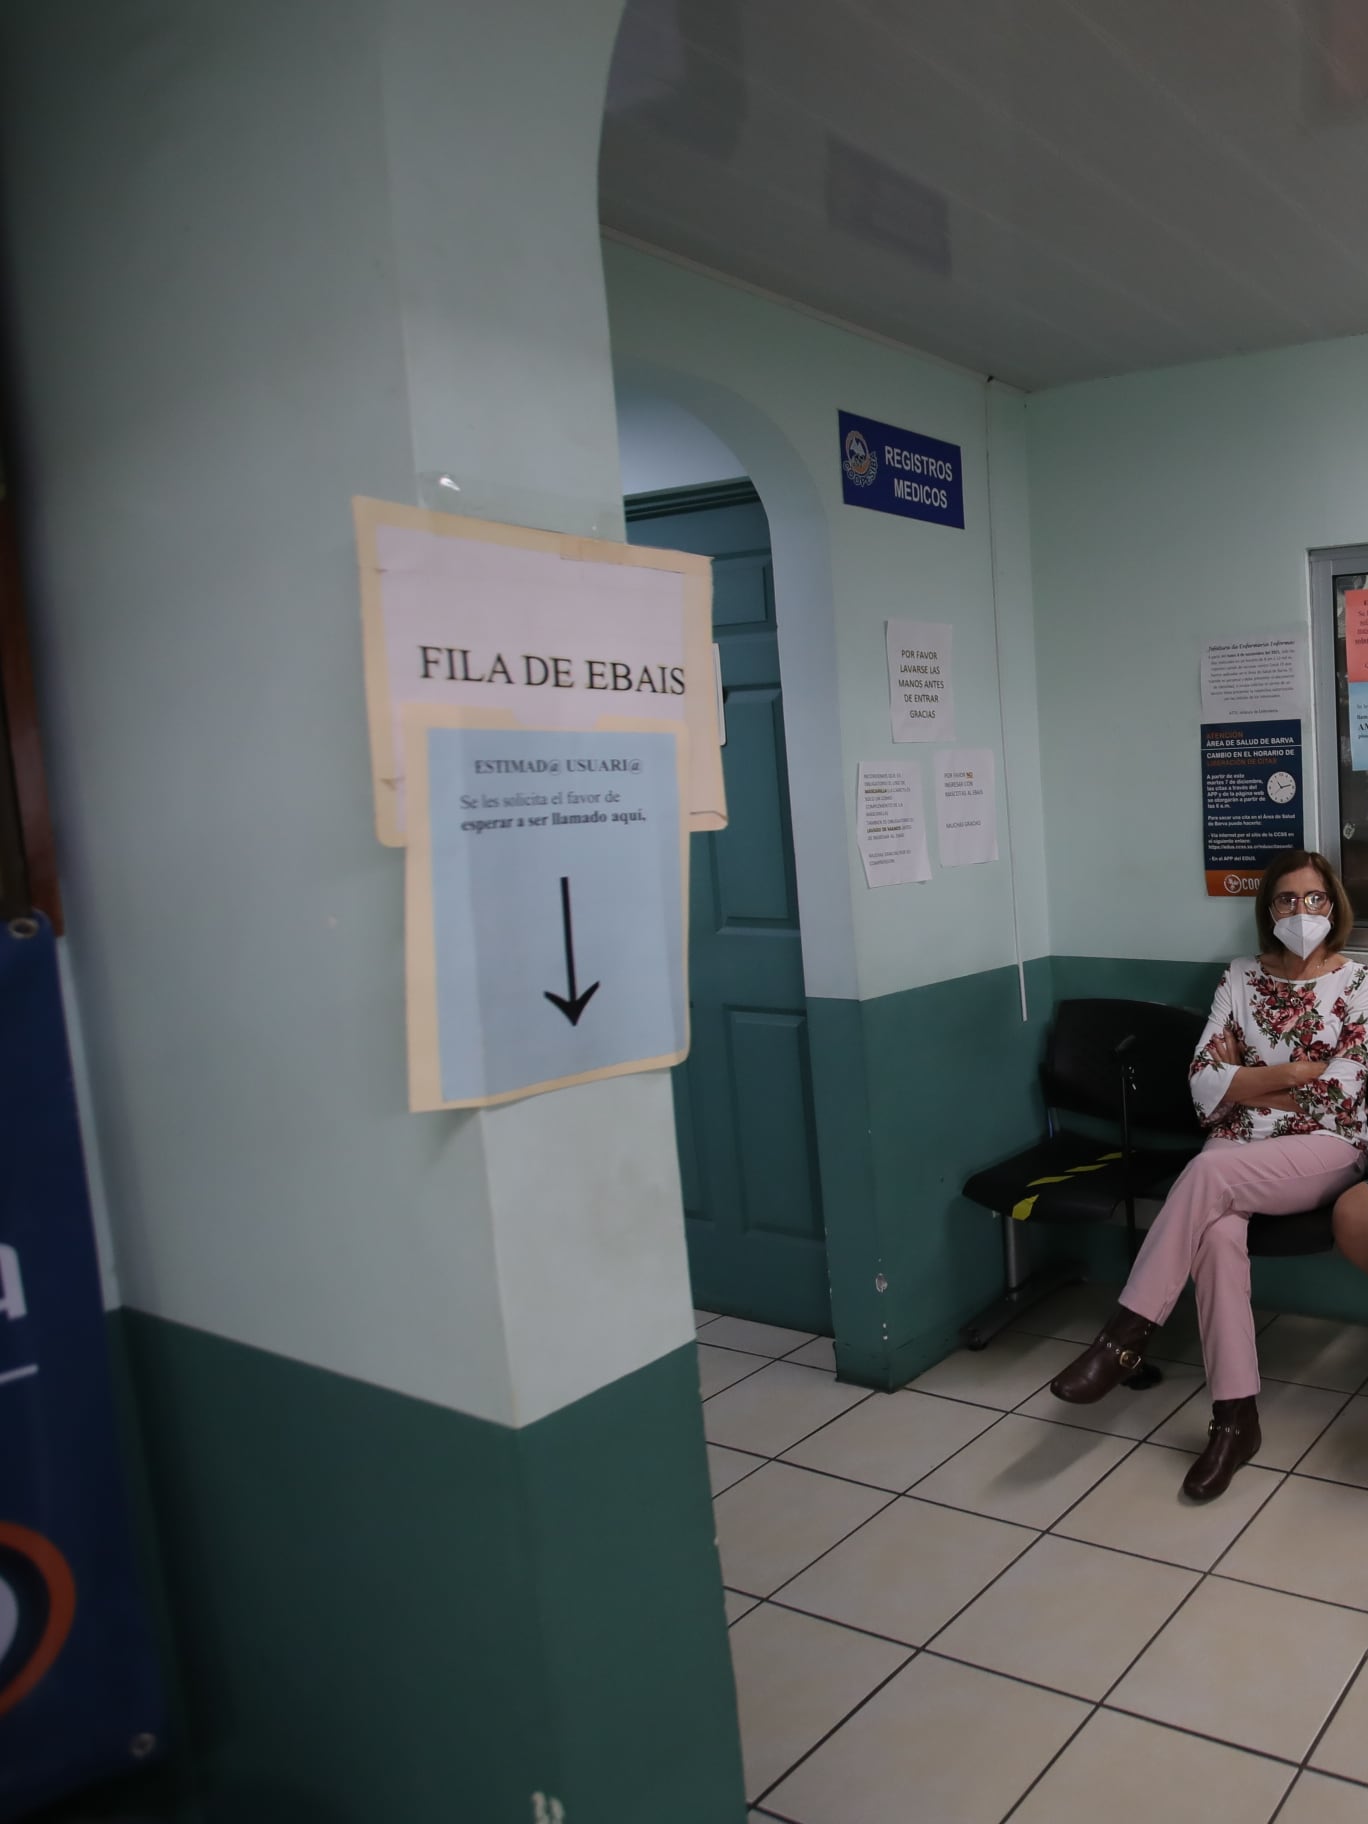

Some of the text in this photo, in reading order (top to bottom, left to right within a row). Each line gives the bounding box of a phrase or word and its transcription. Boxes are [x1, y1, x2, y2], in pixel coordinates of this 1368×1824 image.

[885, 446, 952, 482] REGISTROS
[894, 478, 947, 508] MEDICOS
[901, 649, 937, 660] POR FAVOR
[418, 644, 686, 696] FILA DE EBAIS
[900, 664, 940, 674] LAVARSE LAS
[899, 679, 944, 689] MANOS ANTES
[904, 694, 938, 703] DE ENTRAR
[910, 709, 936, 719] GRACIAS
[1206, 739, 1224, 747] ÁREA
[474, 759, 642, 775] ESTIMAD@ USUARI@
[460, 790, 620, 810] Se les solicita el favor de
[461, 816, 512, 834] esperar
[517, 817, 524, 828] a
[528, 816, 547, 827] ser
[552, 812, 607, 826] llamado
[1242, 878, 1262, 890] COO
